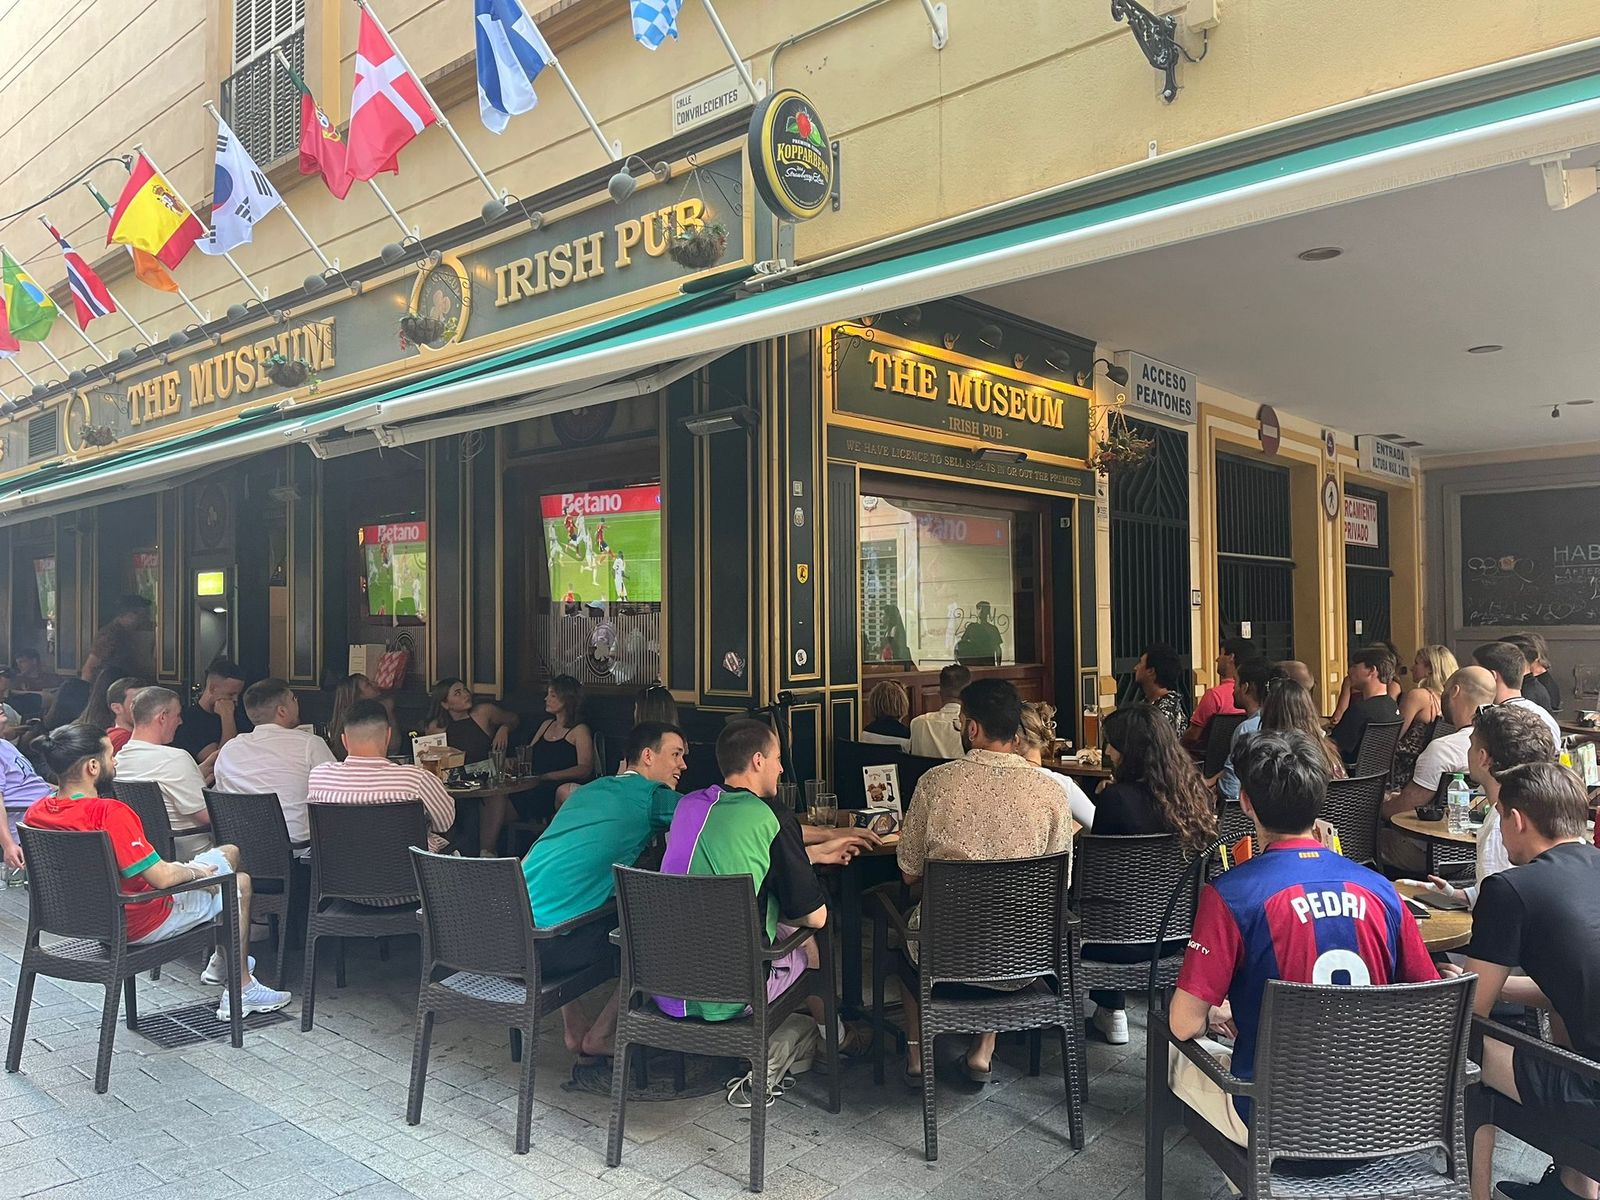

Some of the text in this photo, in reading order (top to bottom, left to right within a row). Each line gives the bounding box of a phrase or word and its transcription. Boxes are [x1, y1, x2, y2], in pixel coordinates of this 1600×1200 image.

[676, 95, 691, 109] CALLE
[676, 89, 738, 125] CONVALECIENTES
[495, 198, 705, 306] IRISH PUB
[127, 316, 336, 426] THE MUSEUM
[1142, 363, 1186, 393] ACCESO
[868, 350, 1064, 429] THE MUSEUM
[1136, 384, 1192, 416] PEATONES
[949, 417, 1003, 440] IRISH PUB
[846, 439, 861, 452] WE
[864, 443, 889, 456] HAVE
[891, 447, 928, 462] LICENCE
[930, 453, 942, 464] TO
[944, 455, 964, 468] SELL
[1007, 466, 1018, 477] OR
[1018, 469, 1034, 479] OUT
[1034, 471, 1049, 481] THE
[1376, 442, 1405, 461] ENTRADA
[561, 493, 622, 515] Betano
[1290, 891, 1367, 924] PEDRI
